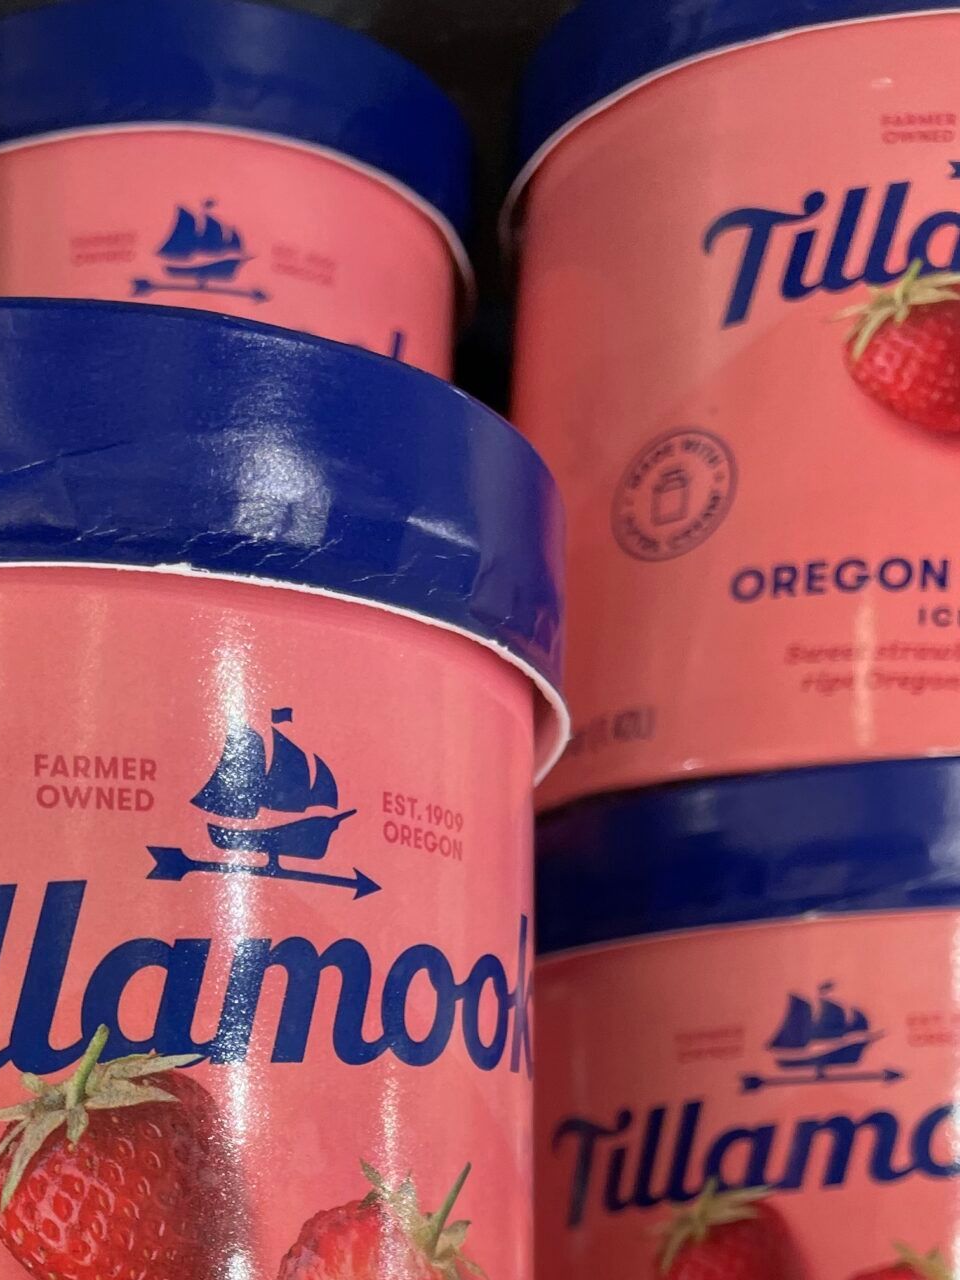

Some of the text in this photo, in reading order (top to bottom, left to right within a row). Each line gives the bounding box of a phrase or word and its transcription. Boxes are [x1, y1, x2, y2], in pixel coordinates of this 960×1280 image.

[730, 556, 950, 604] OREGON
[917, 605, 960, 628] IC
[33, 753, 158, 781] FARMER
[35, 784, 156, 812] OWNED
[382, 790, 465, 834] EST. 1909
[382, 820, 463, 862] OREGON
